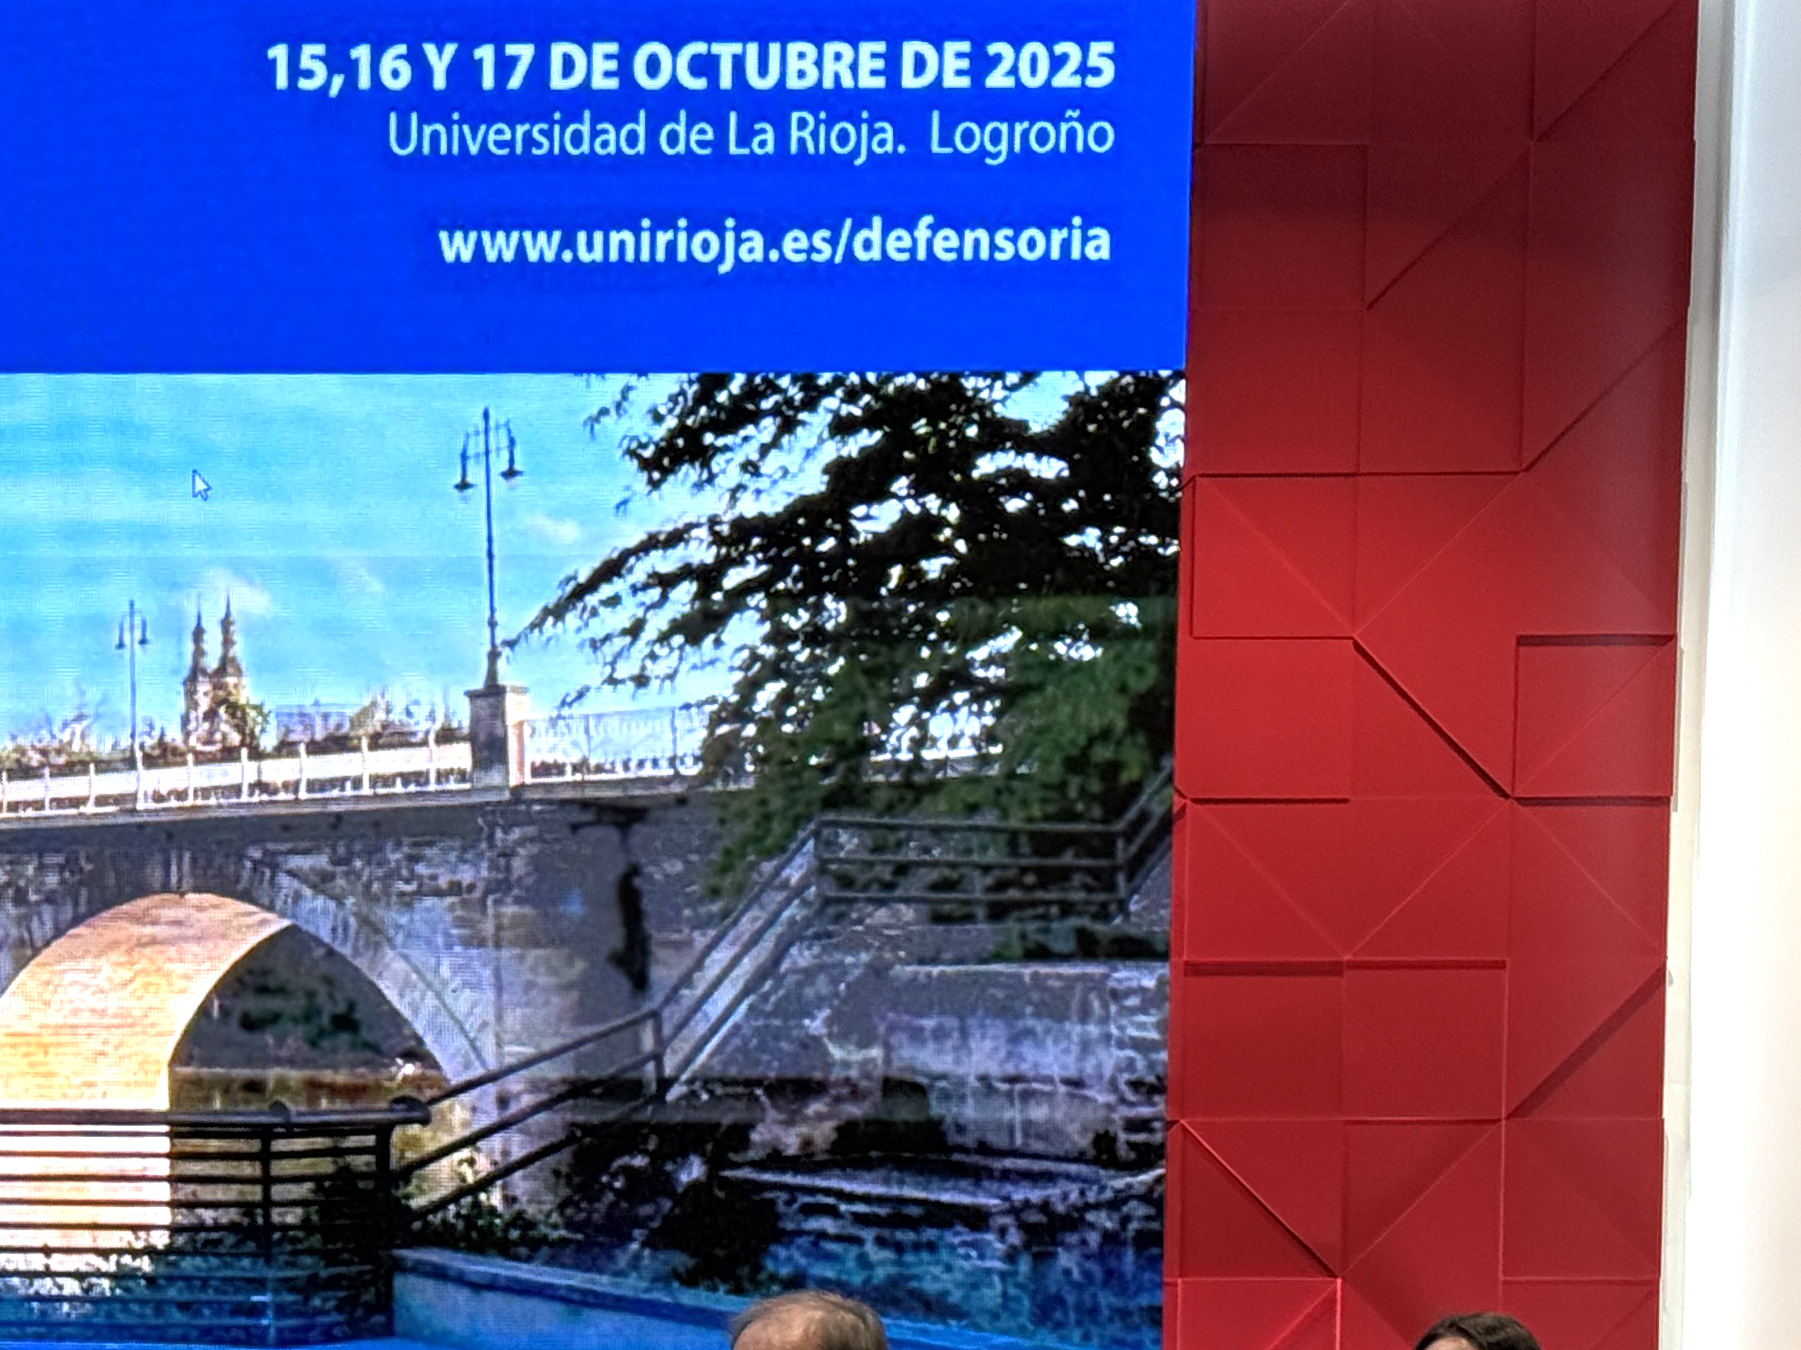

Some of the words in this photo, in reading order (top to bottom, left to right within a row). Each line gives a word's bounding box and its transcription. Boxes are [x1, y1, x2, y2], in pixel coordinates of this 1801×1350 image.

[268, 44, 411, 96] 15,16
[423, 44, 457, 89] Y
[474, 44, 534, 89] 17
[550, 43, 619, 89] DE
[634, 41, 886, 89] OCTUBRE
[902, 41, 970, 88] DE
[986, 42, 1114, 88] 2025
[390, 111, 645, 155] Universidad
[660, 111, 713, 154] de
[730, 112, 774, 154] La
[791, 112, 905, 165] Rioja.
[932, 111, 1114, 165] Logroño
[439, 216, 1109, 273] www.unirioja.es/defensoria
